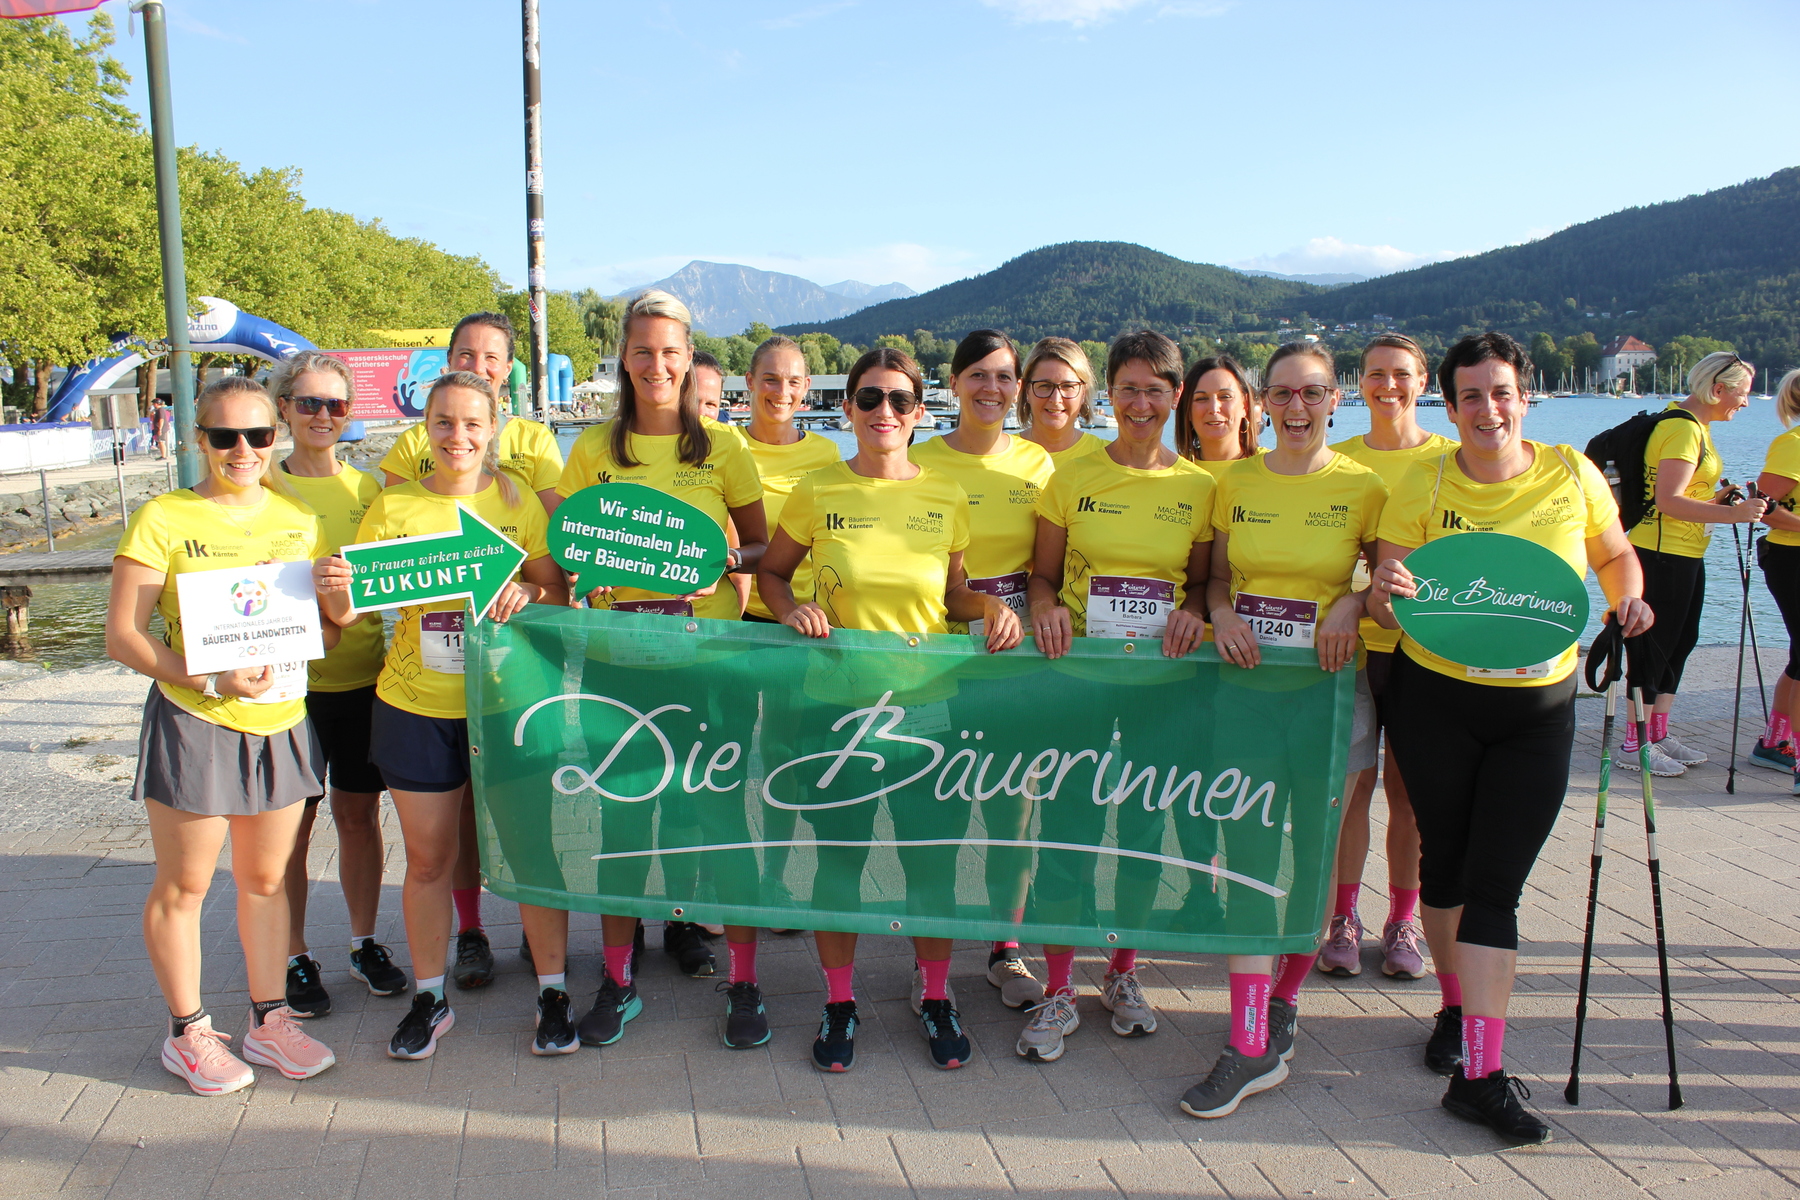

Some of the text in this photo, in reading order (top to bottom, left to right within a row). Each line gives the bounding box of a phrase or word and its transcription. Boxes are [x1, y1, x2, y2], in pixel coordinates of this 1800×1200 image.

[391, 339, 422, 348] ffeisen
[697, 463, 714, 471] WIR
[675, 470, 713, 479] MACHT'S
[672, 477, 714, 487] MÖGLICH
[1009, 489, 1041, 497] MACHT'S
[1099, 501, 1130, 509] Bäuerinnen
[1177, 502, 1193, 512] WIR
[1551, 497, 1570, 506] WIR
[599, 497, 685, 530] Wir sind im
[927, 511, 944, 520] WIR
[1098, 507, 1122, 515] Kärnten
[1157, 505, 1193, 519] MACHT'S
[1248, 510, 1280, 518] Bäuerinnen
[1308, 511, 1347, 520] MACHT'S
[1532, 505, 1573, 519] MACHT'S
[908, 515, 944, 528] MACHT'S
[1153, 513, 1191, 527] MÖGLICH
[1304, 519, 1346, 529] MÖGLICH
[1531, 513, 1575, 528] MÖGLICH
[500, 526, 518, 534] WIR
[906, 522, 944, 535] MÖGLICH
[561, 516, 708, 560] internationalen Jahr
[371, 557, 415, 573] Frauen
[419, 551, 460, 566] wirken
[464, 543, 505, 558] wächst
[564, 543, 700, 585] der Bäuerin 2026
[361, 562, 484, 597] ZUKUNFT
[1404, 576, 1449, 602] Die
[1005, 595, 1025, 610] 208
[1109, 599, 1157, 615] 11230
[213, 619, 265, 631] INTERNATIONALES
[265, 618, 281, 626] JAHR
[1248, 618, 1293, 637] 11240
[202, 625, 307, 646] BÄUERIN & LANDWIRTIN
[1259, 634, 1278, 642] Daniela
[238, 642, 276, 658] 2026
[514, 693, 742, 803] Die
[1246, 1007, 1255, 1032] Frauen
[1246, 1032, 1255, 1046] Wo
[1259, 1022, 1267, 1049] wächst
[1474, 1052, 1483, 1078] wächst
